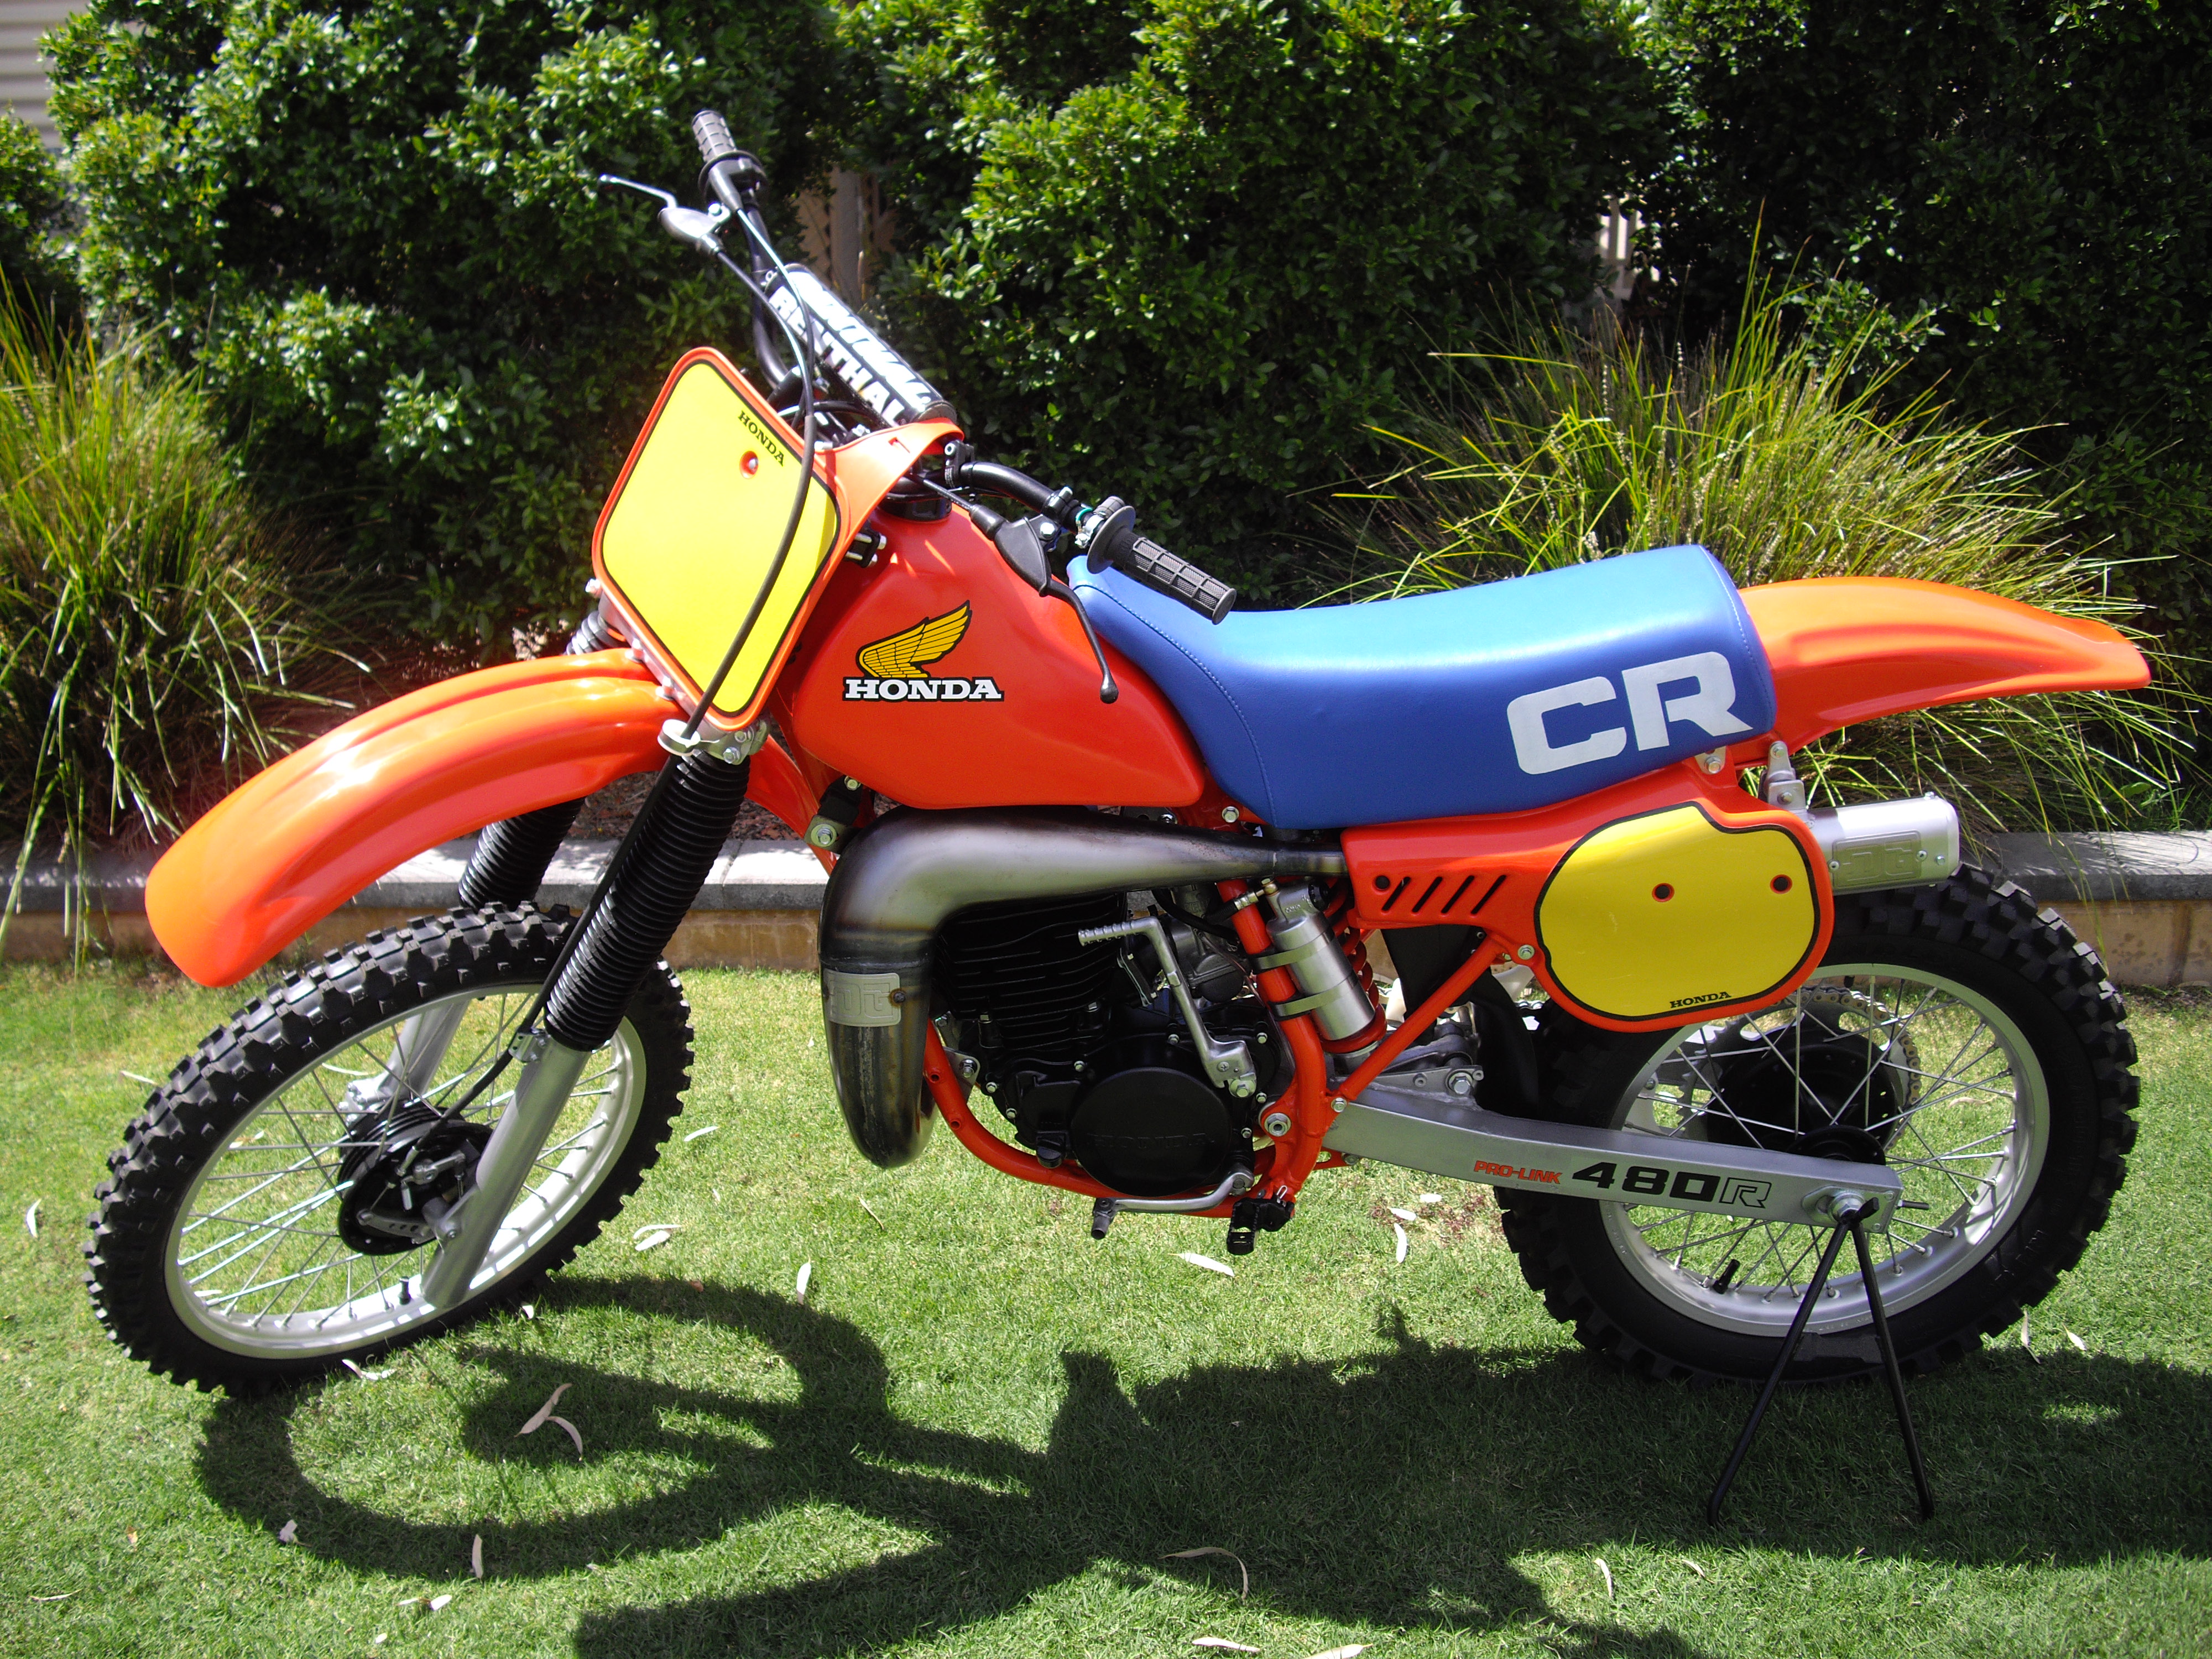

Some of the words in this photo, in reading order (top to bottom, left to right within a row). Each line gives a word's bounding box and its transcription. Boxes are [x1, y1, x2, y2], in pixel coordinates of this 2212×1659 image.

[738, 411, 785, 466] HONDA
[846, 679, 1001, 700] HONDA
[1507, 651, 1753, 775] CR
[1670, 991, 1731, 1009] HONDA
[1474, 1161, 1562, 1184] PRO-LINK
[1572, 1162, 1771, 1208] 480R
